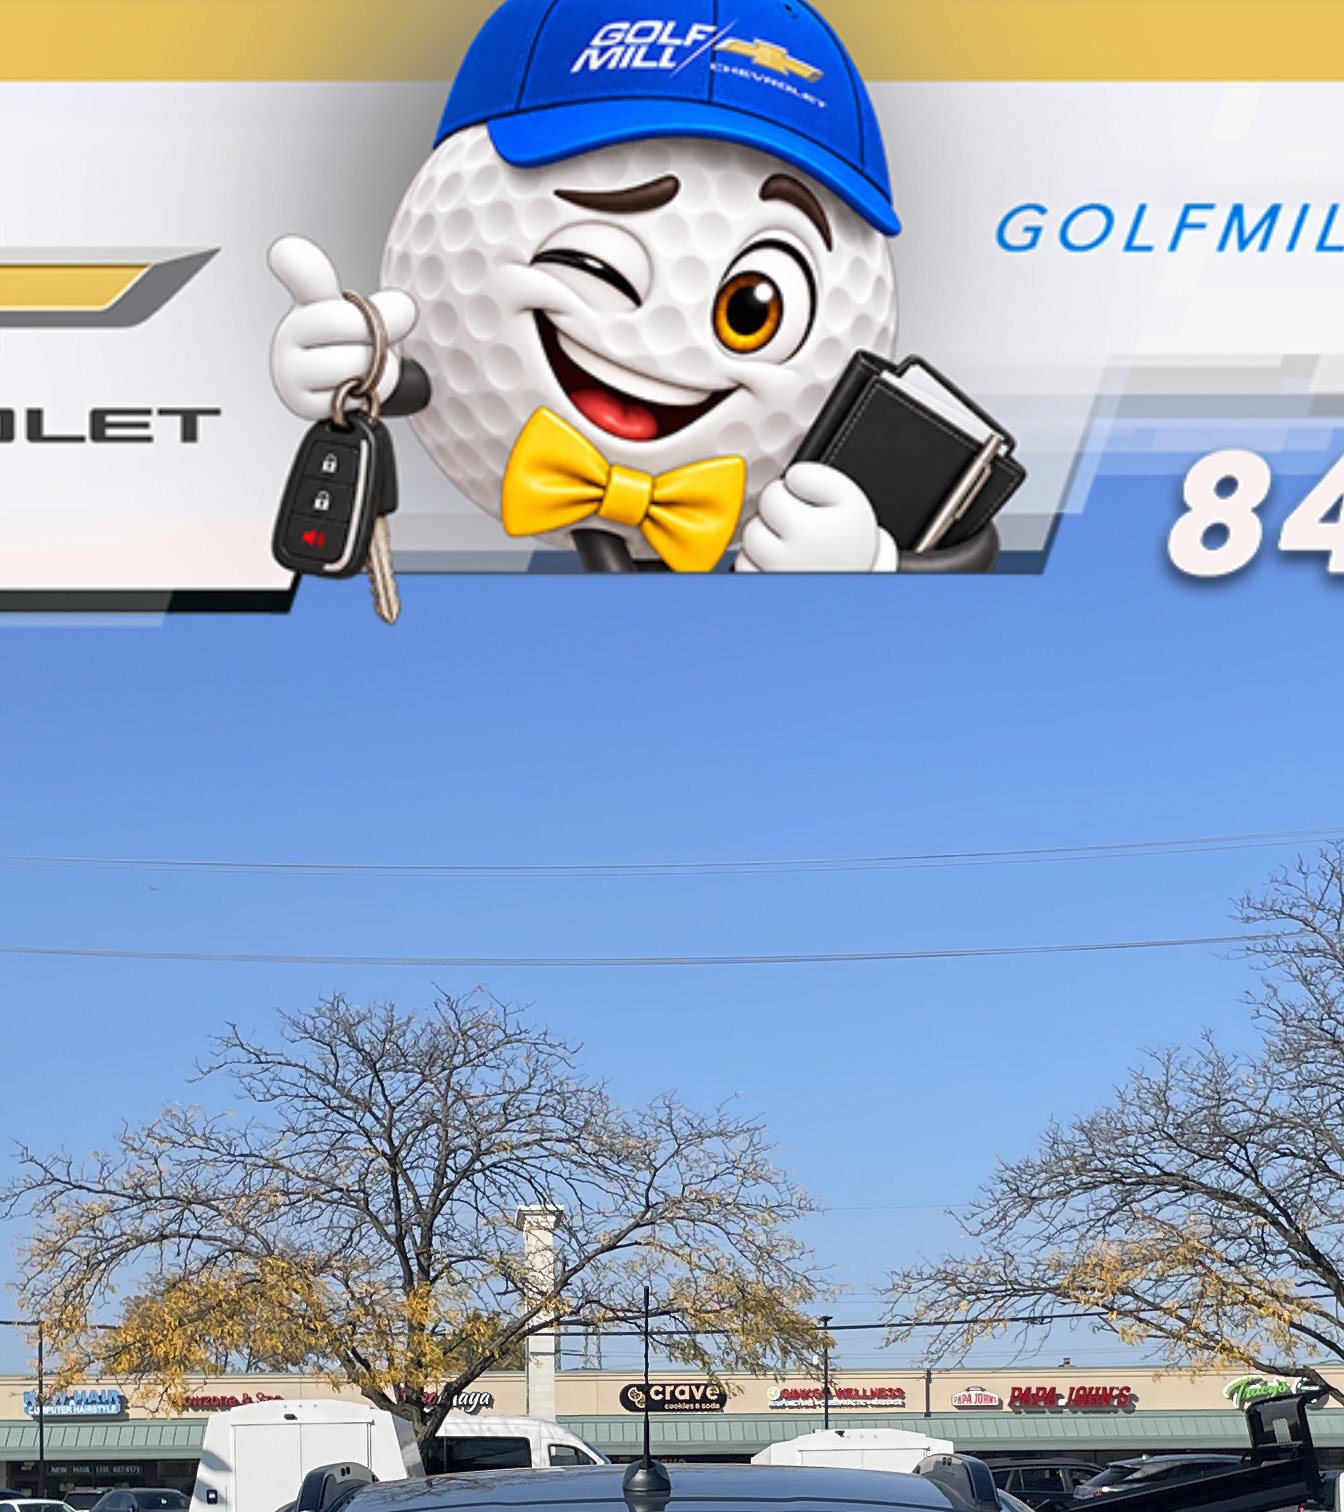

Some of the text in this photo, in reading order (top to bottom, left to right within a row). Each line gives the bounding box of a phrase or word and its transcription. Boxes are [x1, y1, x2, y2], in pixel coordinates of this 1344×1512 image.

[73, 1390, 120, 1403] HAIR
[649, 1384, 721, 1400] crave
[1009, 1386, 1057, 1408] PAPA
[452, 1391, 490, 1413] aya
